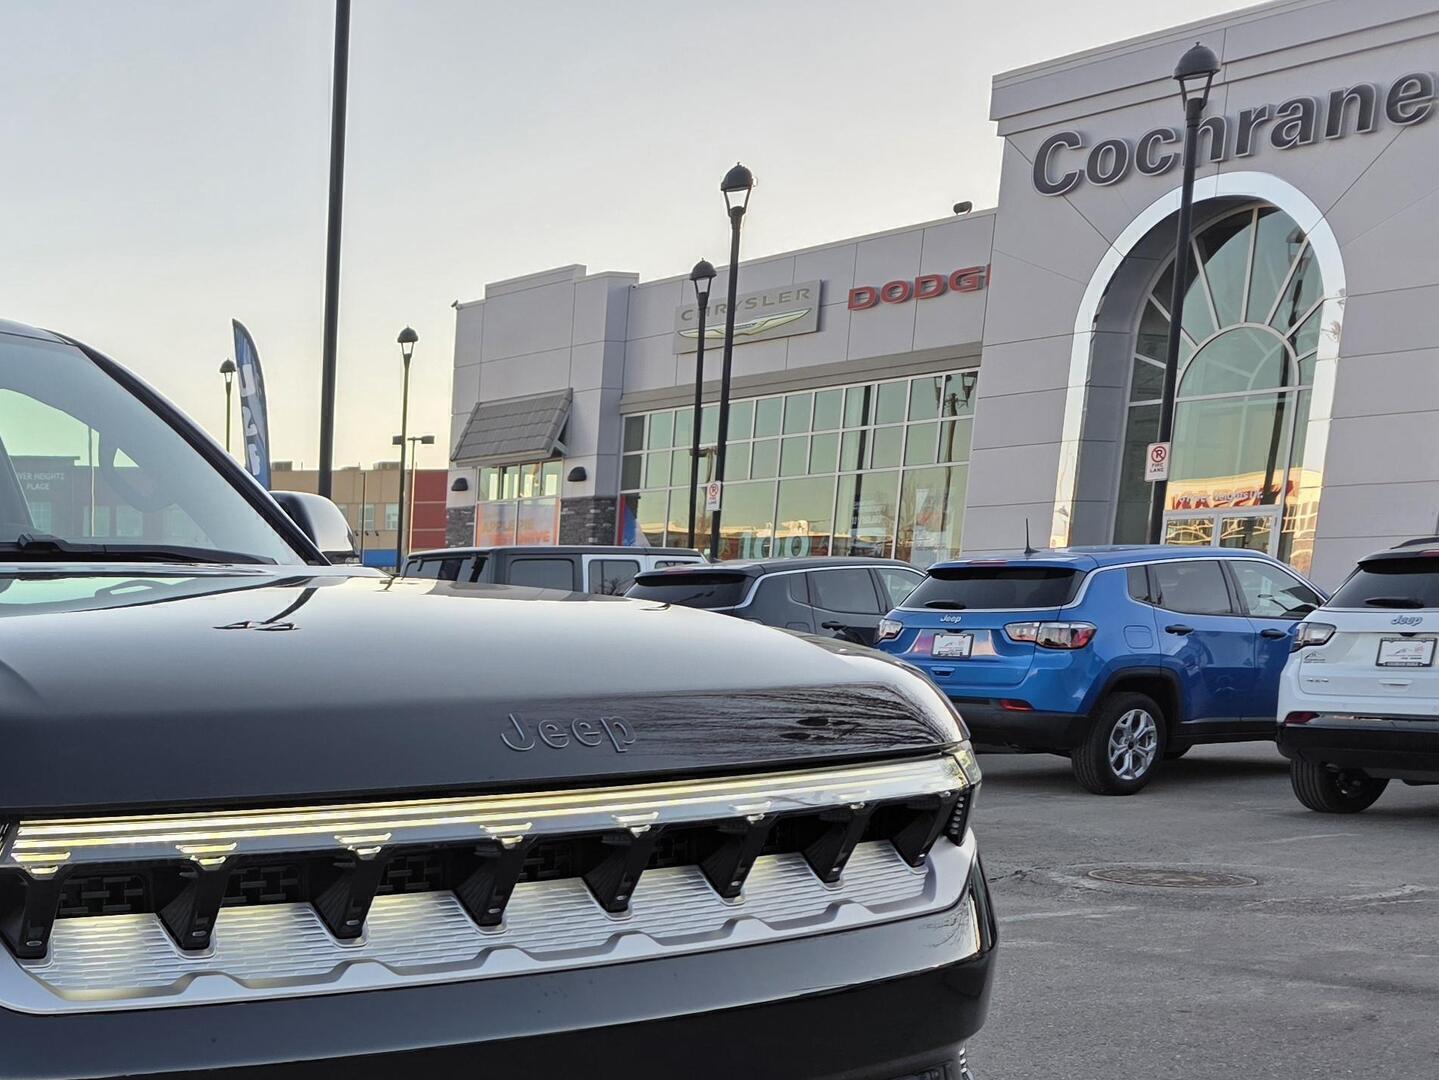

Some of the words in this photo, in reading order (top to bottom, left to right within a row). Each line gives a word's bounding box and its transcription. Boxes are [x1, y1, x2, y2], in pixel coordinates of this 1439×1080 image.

[1032, 70, 1437, 198] Cochrane
[847, 263, 991, 311] DODG
[940, 614, 962, 624] Jeep
[1390, 614, 1424, 627] Jeep
[500, 712, 638, 753] Jeep
